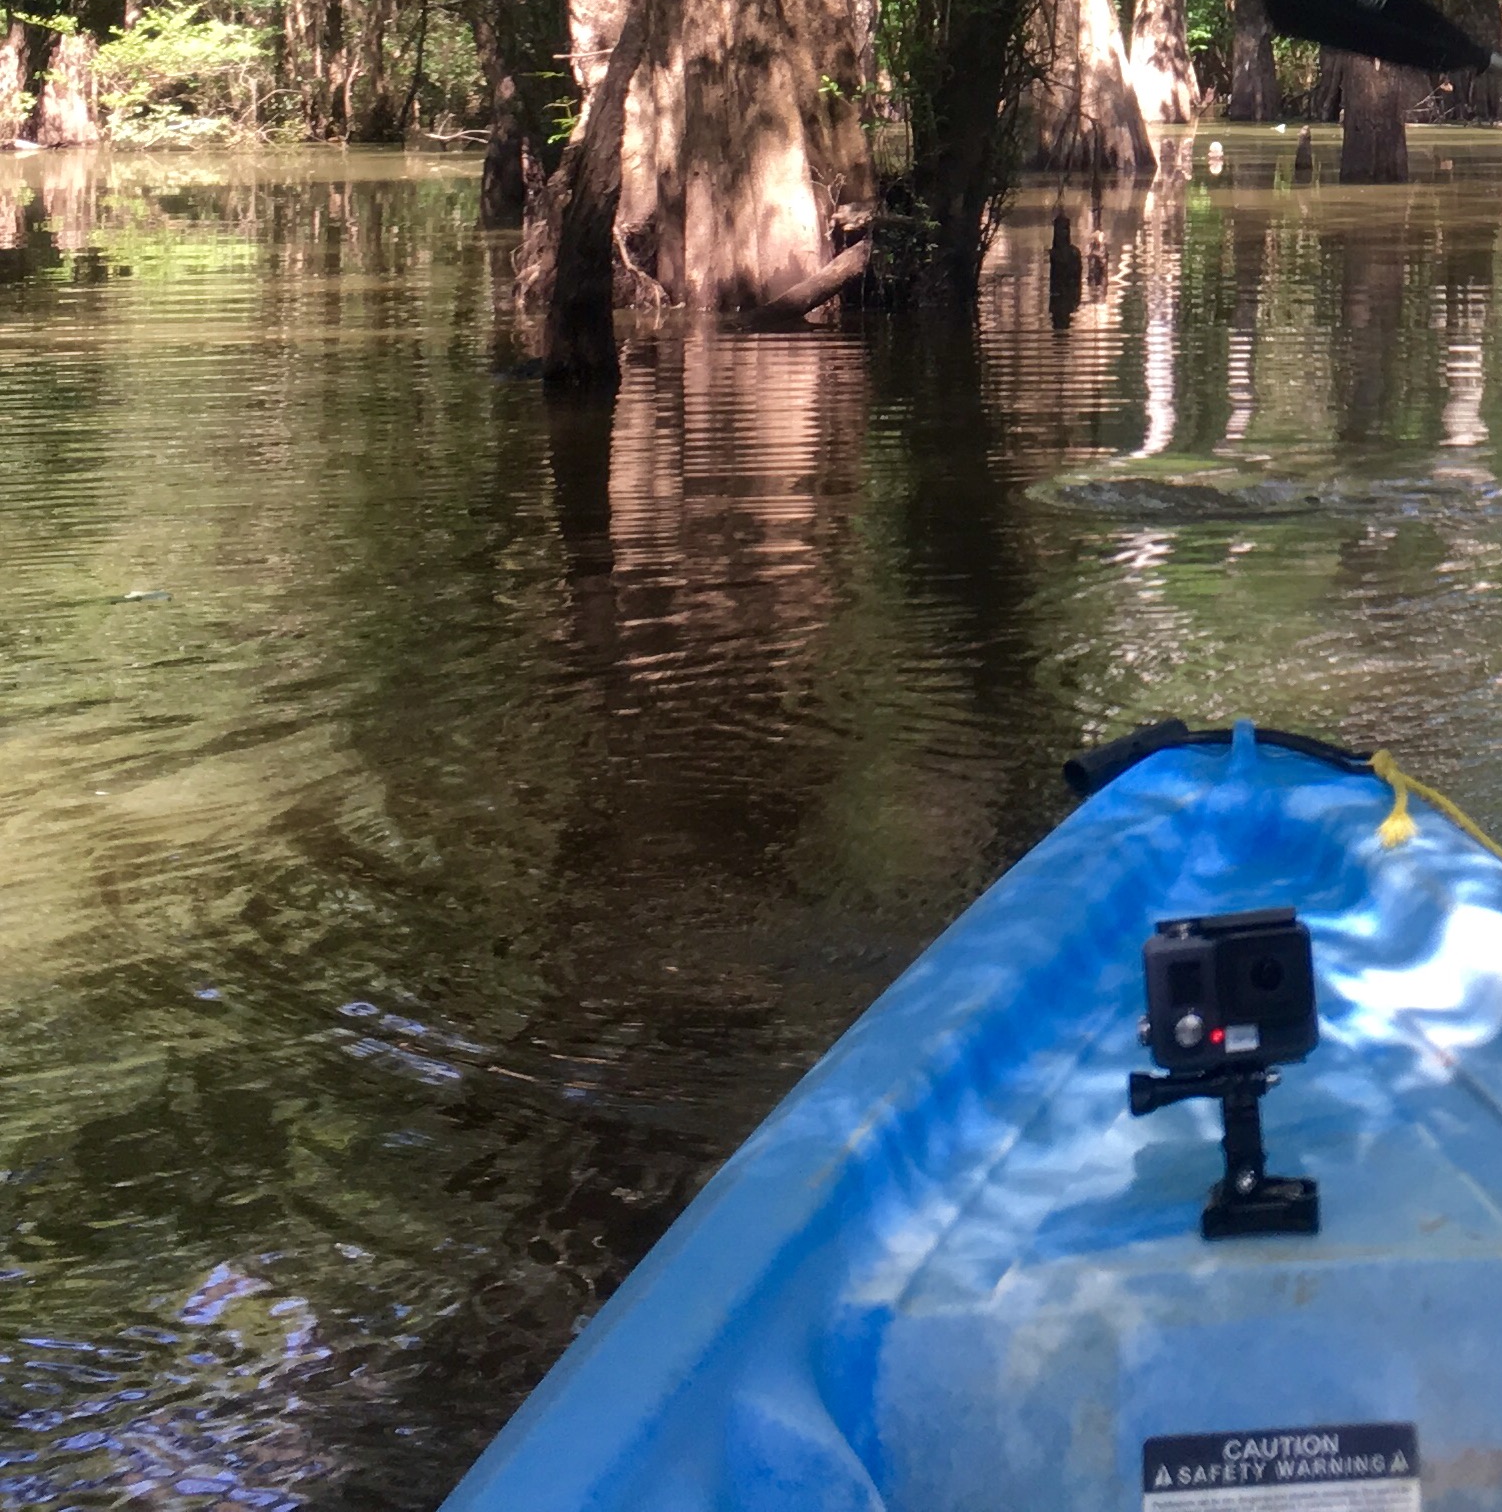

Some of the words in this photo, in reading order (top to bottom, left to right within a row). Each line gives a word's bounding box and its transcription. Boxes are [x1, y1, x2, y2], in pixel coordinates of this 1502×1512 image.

[1223, 1433, 1340, 1461] CAUTION
[1177, 1462, 1266, 1486] SAFETY
[1275, 1453, 1387, 1479] WARNING
